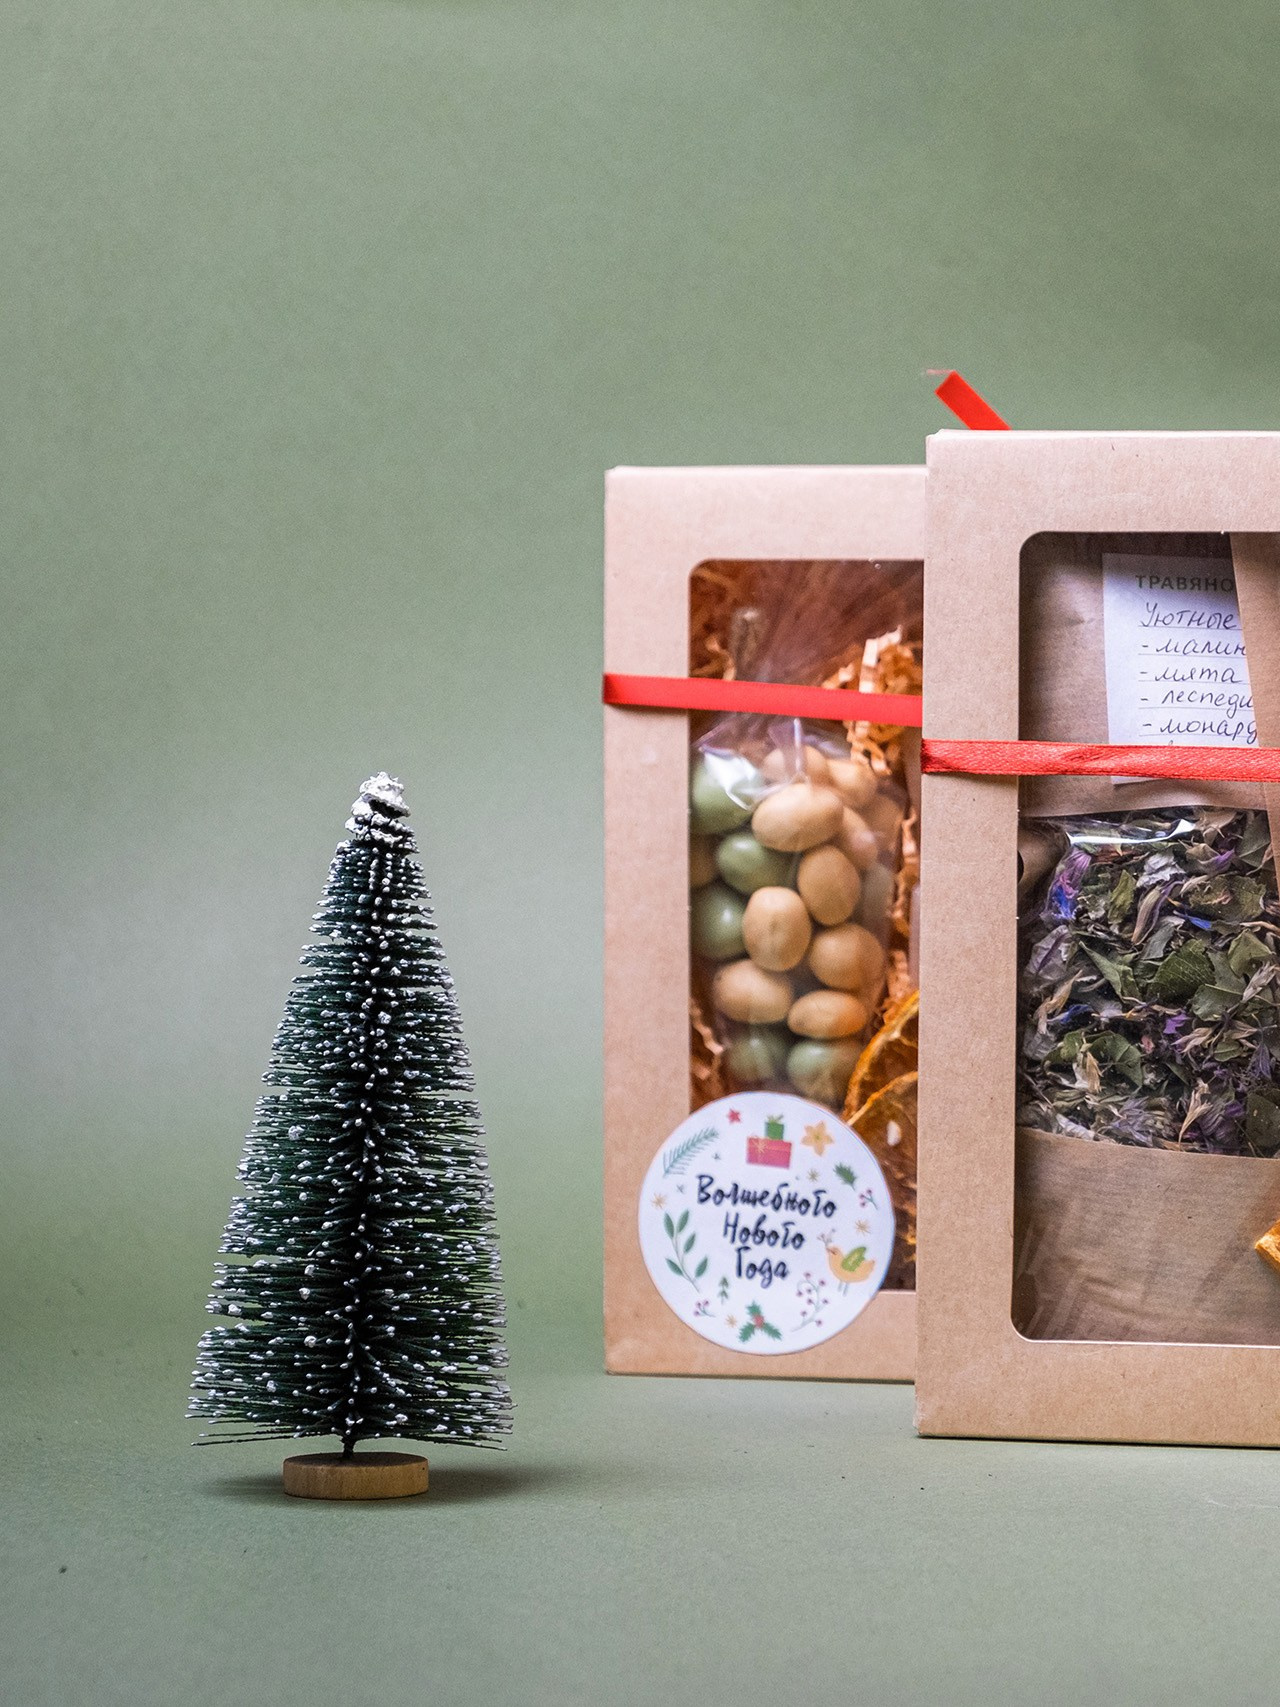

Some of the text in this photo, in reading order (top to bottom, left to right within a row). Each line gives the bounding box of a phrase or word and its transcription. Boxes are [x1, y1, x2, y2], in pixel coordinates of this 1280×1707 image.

[1140, 602, 1238, 630] Уютные
[696, 1174, 838, 1218] Волшебного
[723, 1212, 806, 1250] Нового
[735, 1246, 790, 1289] Года
